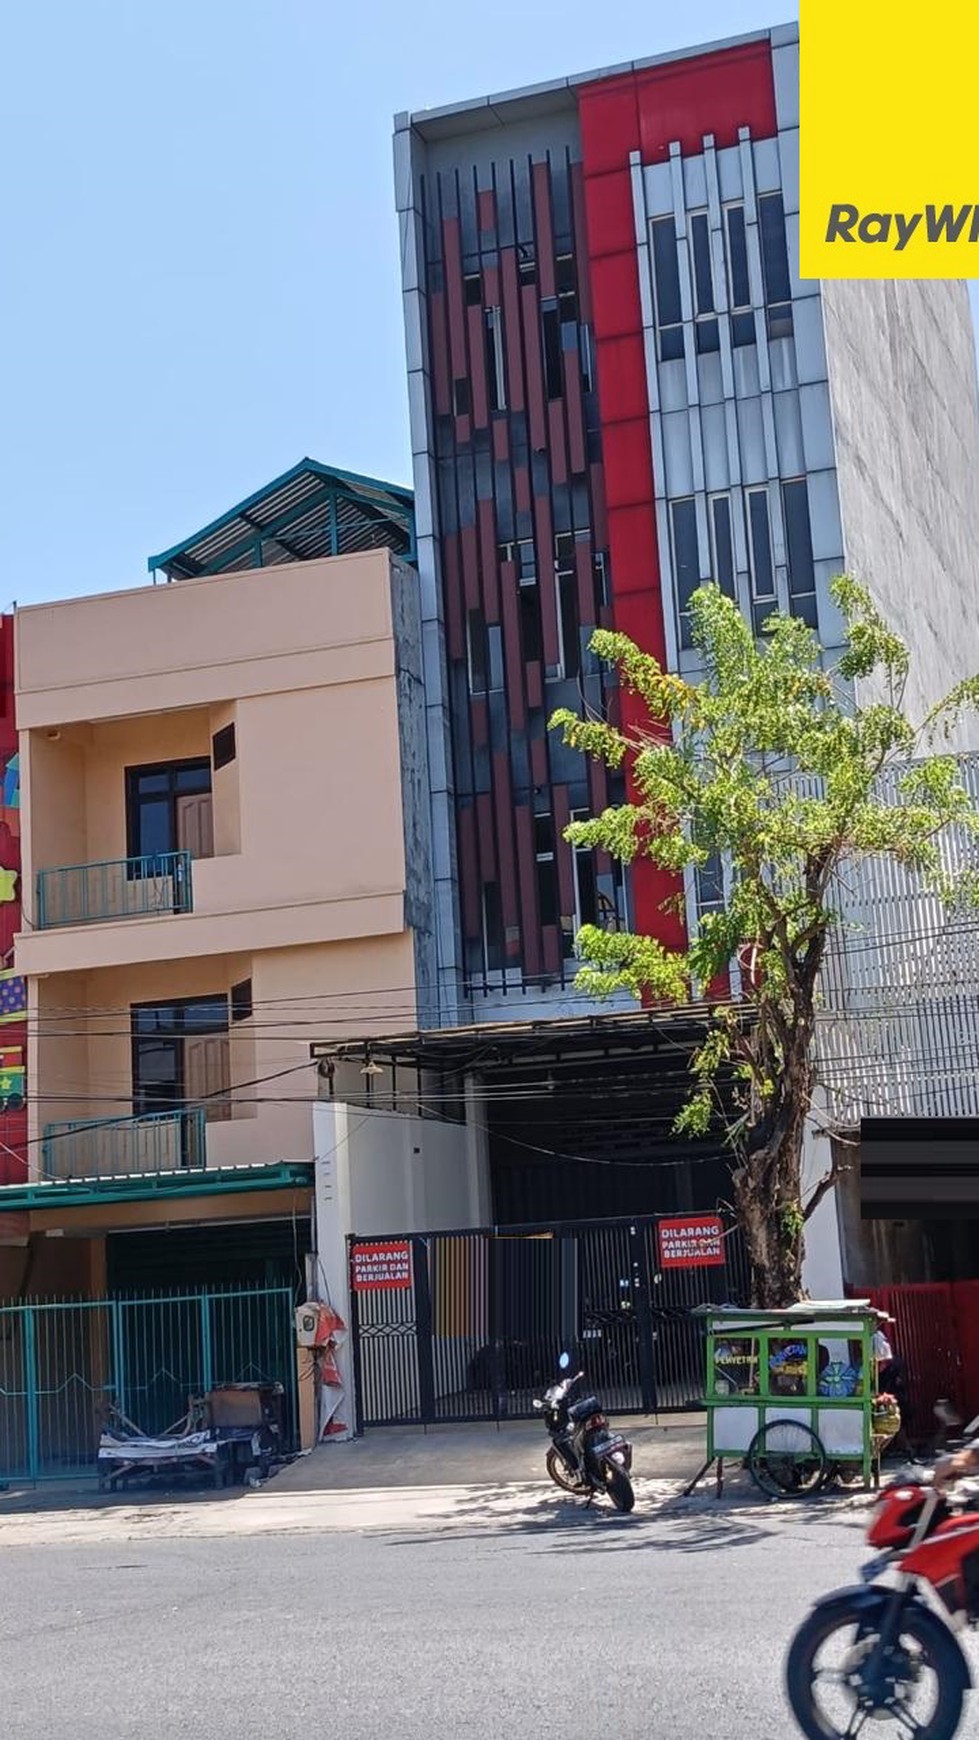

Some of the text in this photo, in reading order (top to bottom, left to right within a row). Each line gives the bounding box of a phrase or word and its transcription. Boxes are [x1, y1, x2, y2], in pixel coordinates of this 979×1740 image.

[661, 1225, 719, 1239] DILARANG
[354, 1251, 408, 1263] DILARANG
[663, 1247, 720, 1258] BERJUALAN
[355, 1262, 409, 1273] PARKIR DAN
[356, 1271, 408, 1282] BERJUALAN
